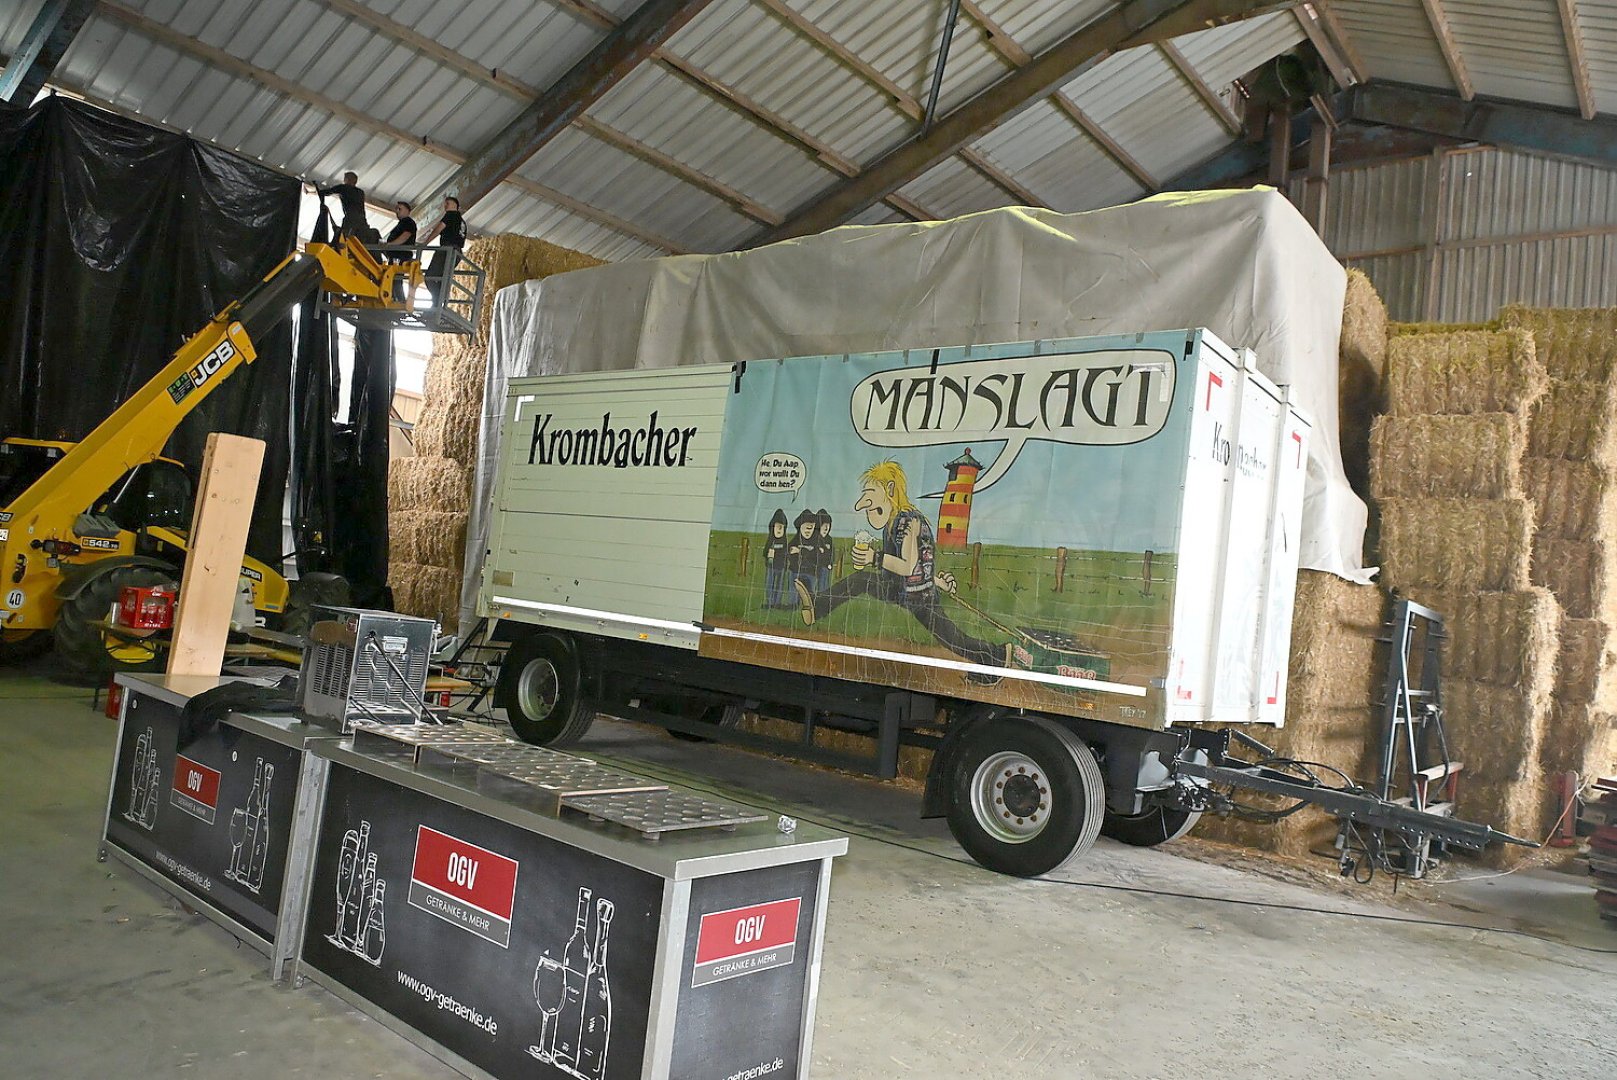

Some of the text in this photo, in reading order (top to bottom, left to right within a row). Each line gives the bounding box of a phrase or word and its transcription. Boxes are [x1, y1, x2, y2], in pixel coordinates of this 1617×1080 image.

[194, 341, 234, 386] JCB
[863, 363, 1165, 433] MANSLAGT
[528, 410, 697, 468] Krombacher
[772, 459, 782, 468] Du
[790, 469, 800, 478] Du
[9, 593, 22, 606] 40
[188, 769, 203, 792] OGV
[447, 852, 478, 890] OGV
[426, 894, 490, 931] GETRÄNKE & MEHR
[734, 914, 766, 945] OGV
[750, 958, 756, 967] &
[757, 952, 777, 965] MEHR
[397, 970, 498, 1035] www.ogv-getraenke.de
